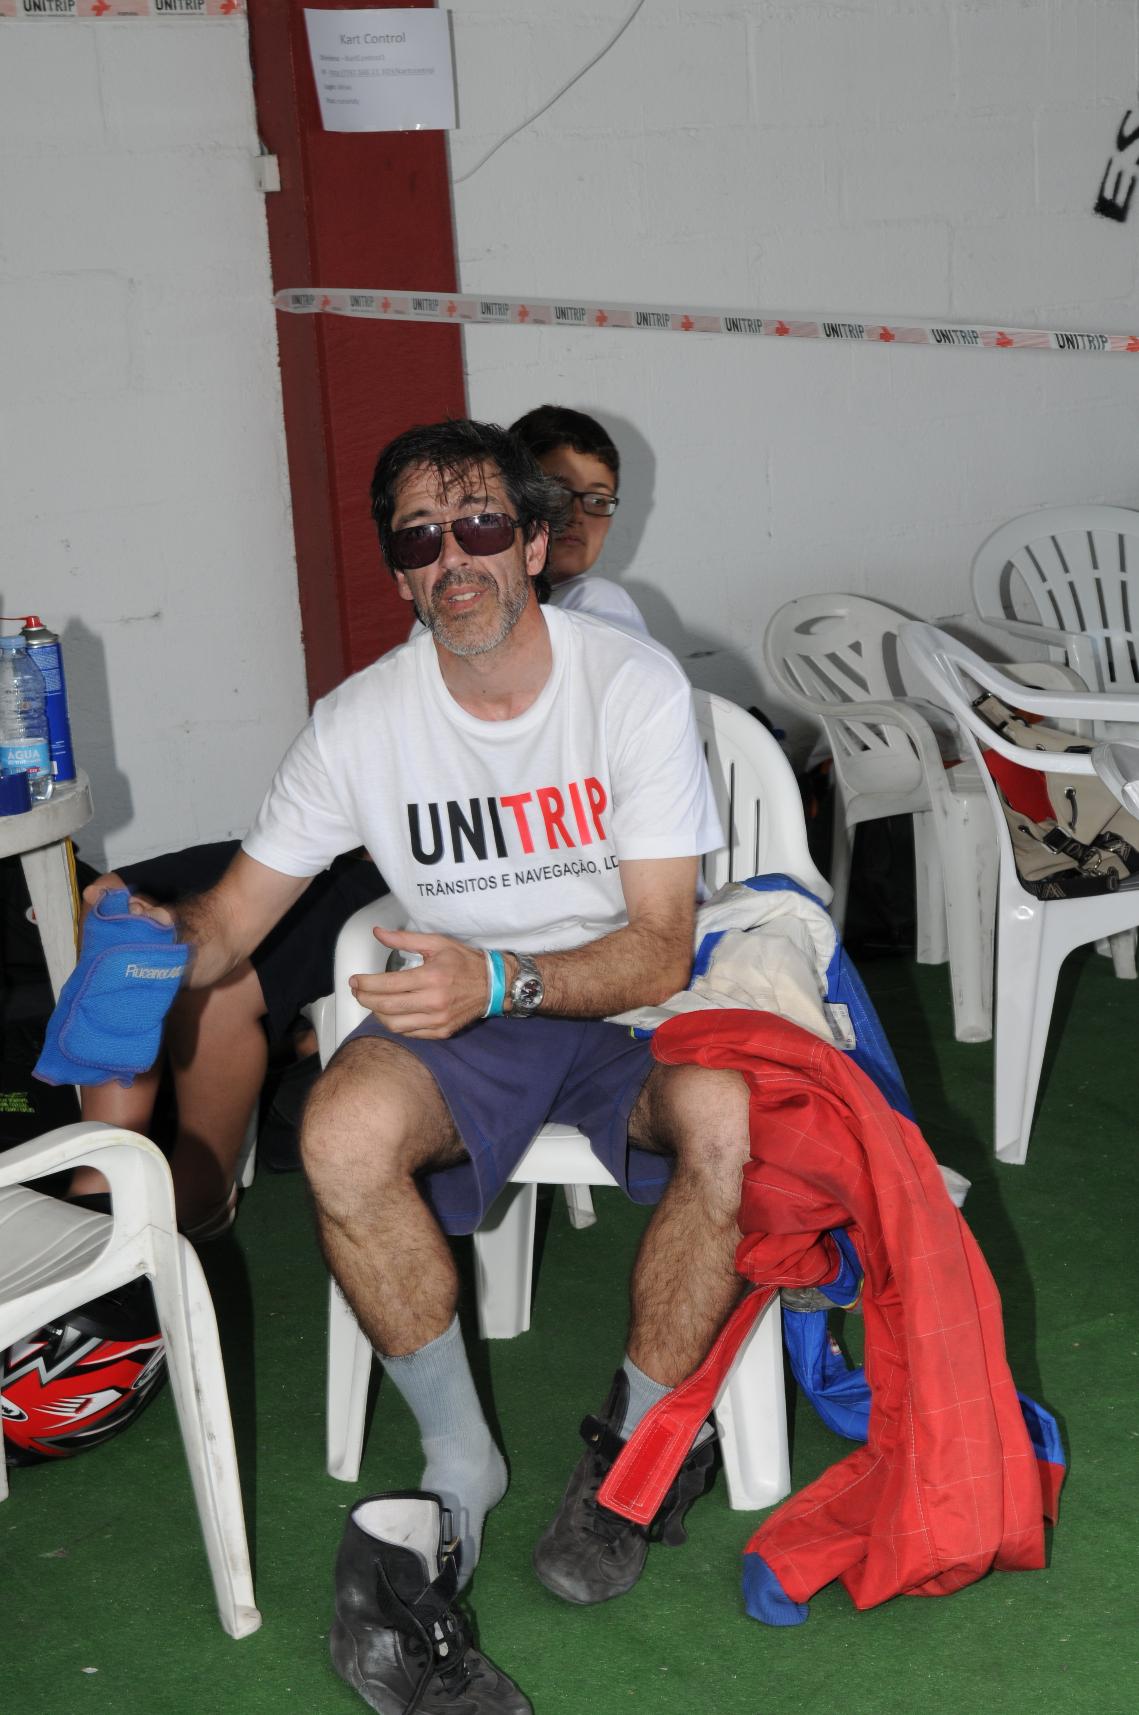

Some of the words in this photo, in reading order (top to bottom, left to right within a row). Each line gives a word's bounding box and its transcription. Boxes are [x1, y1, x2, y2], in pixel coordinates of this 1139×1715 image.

[23, 0, 76, 12] UNITRIP
[155, 0, 205, 11] UNITRIP
[339, 34, 361, 45] Kart
[364, 32, 406, 45] Control
[412, 297, 439, 311] UNITRIP
[480, 302, 509, 316] UNITRIP
[554, 306, 586, 321] UNITRIP
[636, 311, 670, 328] UNITRIP
[724, 317, 763, 333] UNITRIP
[822, 322, 865, 339] UNITRIP
[931, 328, 980, 345] UNITRIP
[1054, 333, 1108, 350] UNITRIP
[407, 776, 608, 866] UNITRIP
[416, 874, 498, 897] TRÂNSITOS
[502, 873, 512, 888] E
